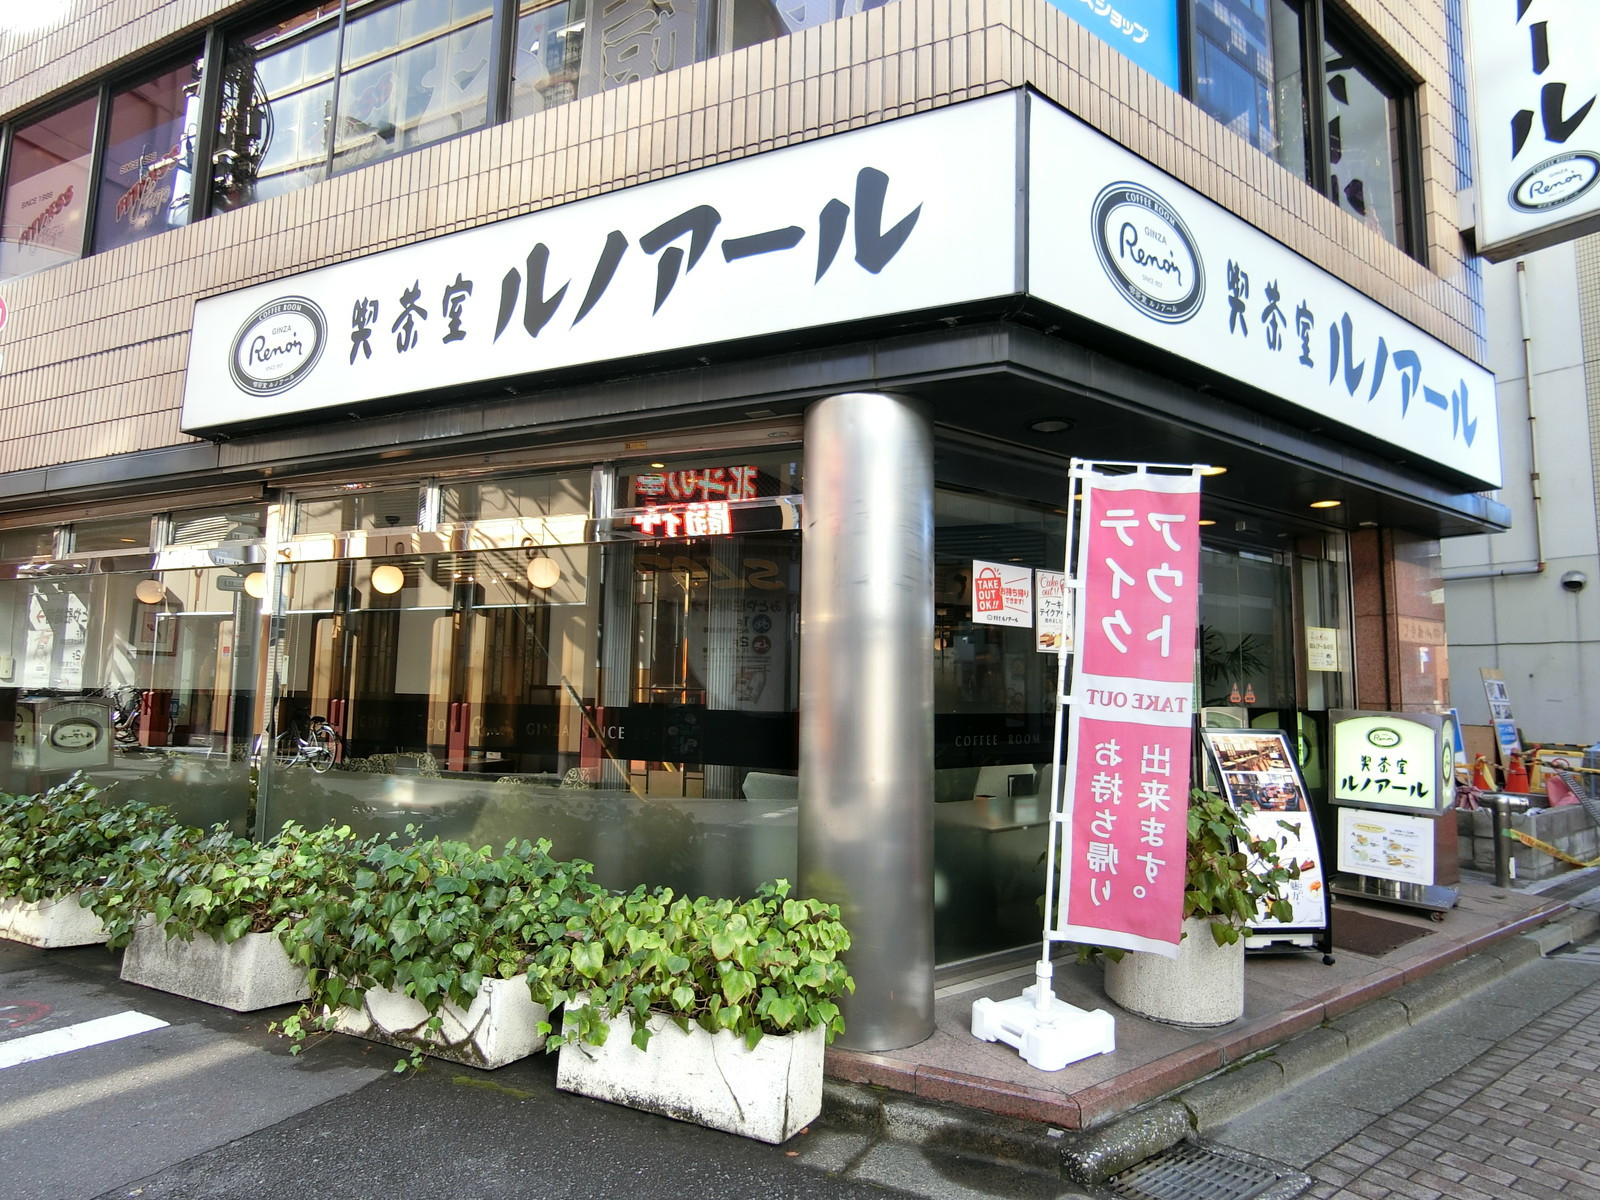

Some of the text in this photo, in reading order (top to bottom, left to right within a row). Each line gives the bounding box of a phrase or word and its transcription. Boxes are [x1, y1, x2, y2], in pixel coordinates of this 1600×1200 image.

[1508, 0, 1597, 161] ール
[1125, 192, 1176, 227] COFFEE ROOM
[1144, 226, 1168, 246] GINZA
[349, 166, 925, 367] 喫茶室 ルノアール
[258, 303, 302, 321] COFFEE ROOM
[271, 324, 292, 336] GINZA
[1226, 258, 1478, 449] 喫茶室 ルノアール
[977, 579, 999, 590] TAKE
[978, 590, 996, 600] OUT
[1000, 586, 1030, 599] お持ち帰り
[979, 600, 999, 611] OK!!
[1045, 600, 1064, 609] ケーキ
[1040, 608, 1071, 619] テイクアト
[955, 734, 1040, 747] COFFEE ROOM
[1360, 755, 1408, 775] 喫茶室
[1341, 775, 1429, 798] ルノアール
